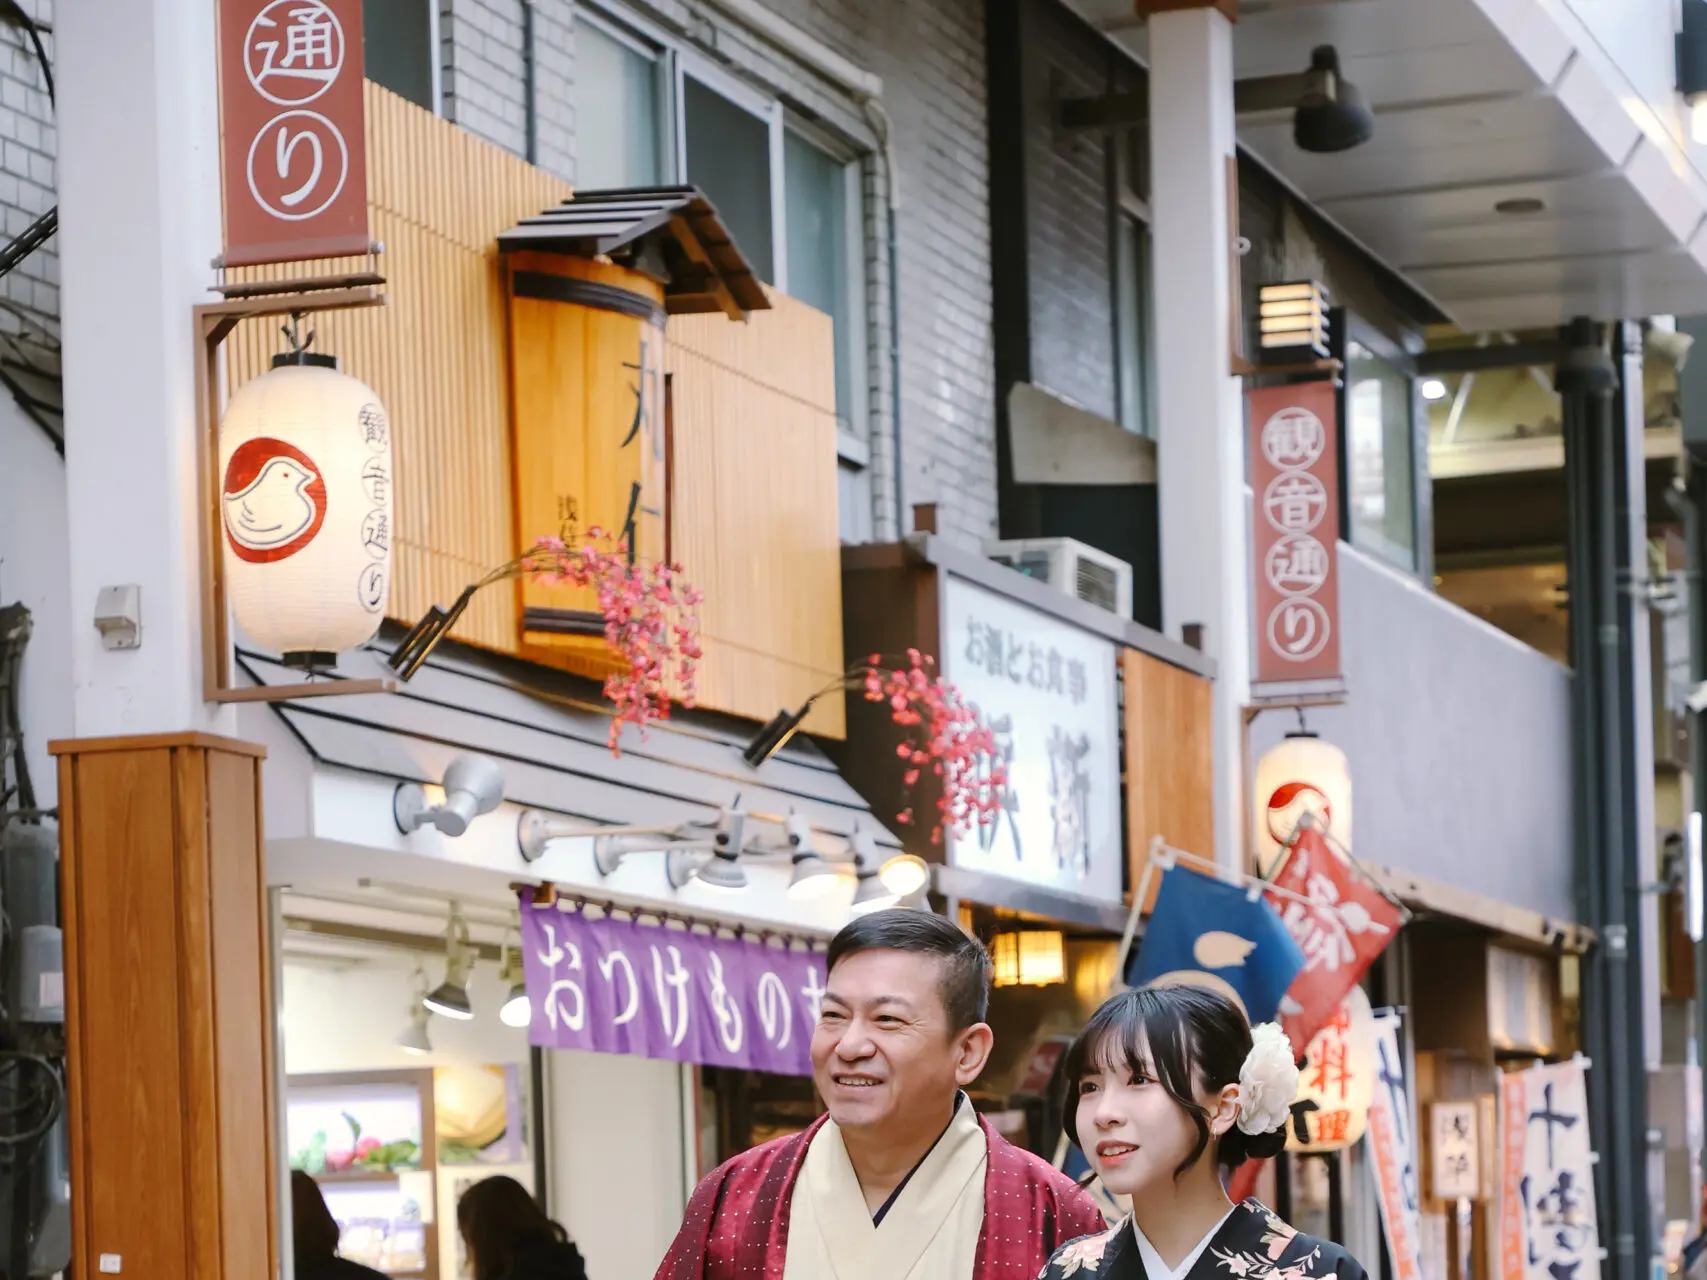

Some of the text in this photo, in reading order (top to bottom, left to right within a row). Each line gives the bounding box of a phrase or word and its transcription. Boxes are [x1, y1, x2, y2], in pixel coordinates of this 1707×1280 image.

[246, 3, 344, 214] 通り
[1263, 409, 1328, 658] 観音通り
